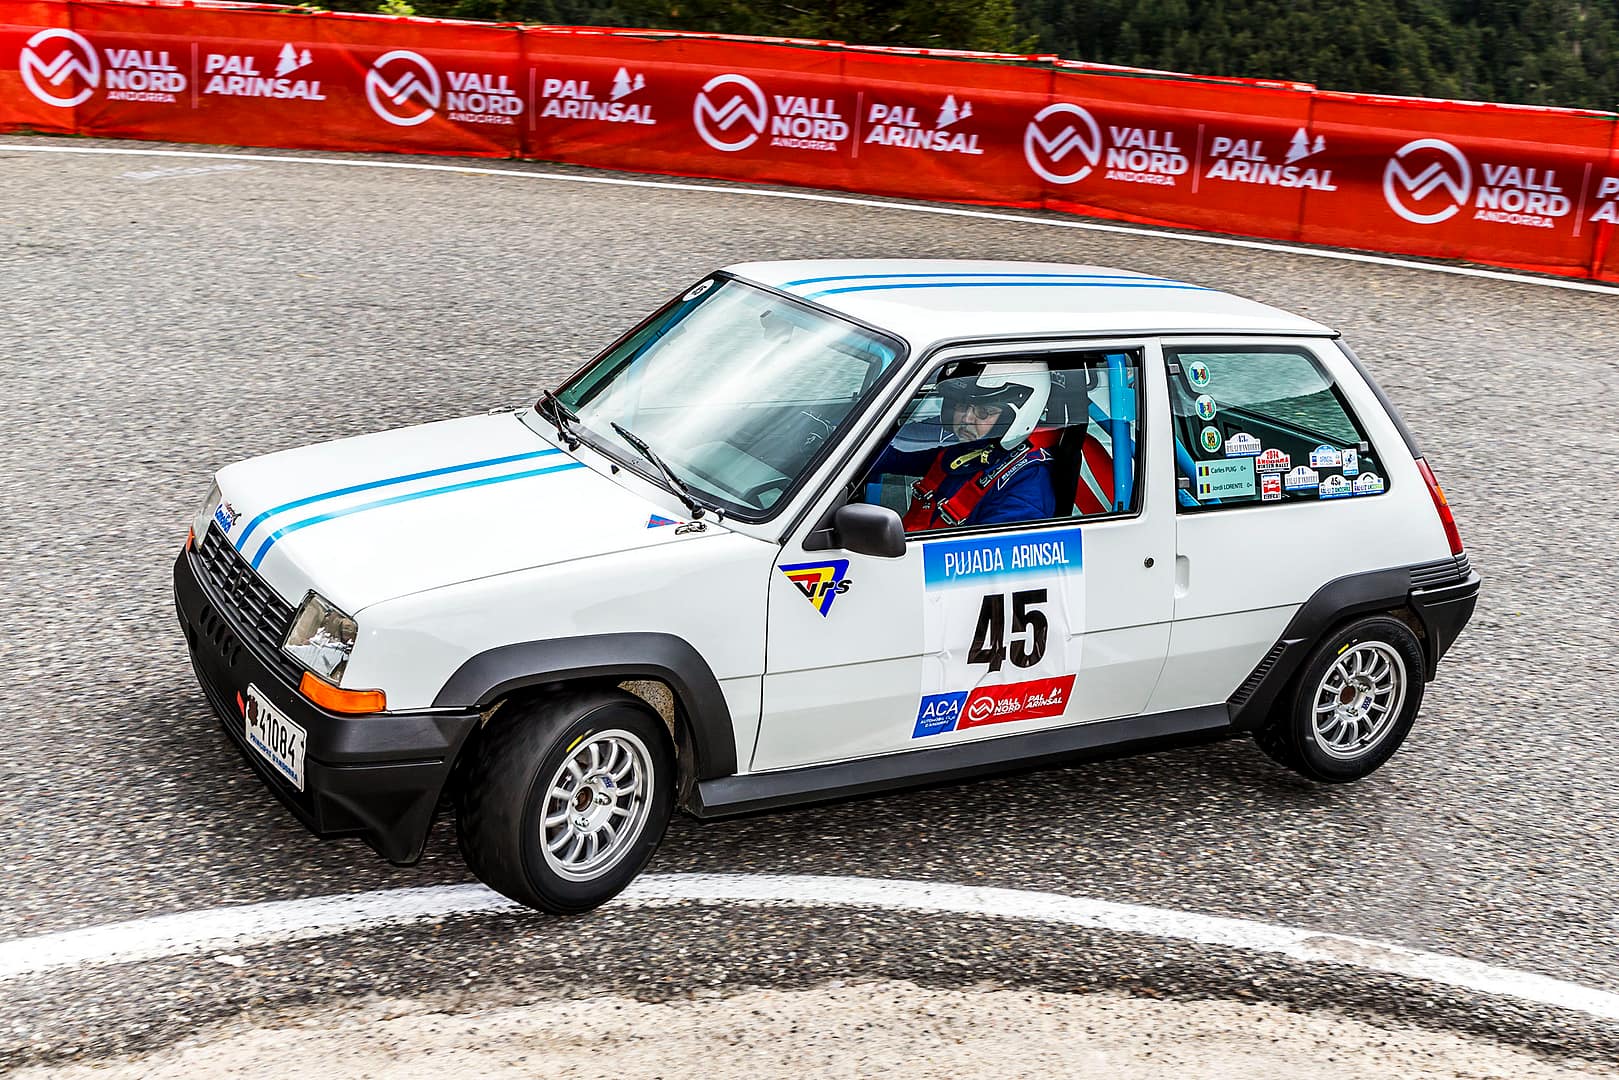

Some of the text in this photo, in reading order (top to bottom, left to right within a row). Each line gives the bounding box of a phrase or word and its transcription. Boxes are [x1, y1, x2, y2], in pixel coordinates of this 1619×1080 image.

[105, 49, 177, 72] VALL
[206, 54, 259, 76] PAL
[106, 69, 187, 93] NORD
[204, 75, 327, 101] ARINSAL
[447, 72, 515, 95] VALL
[543, 79, 593, 100] PAL
[107, 90, 176, 104] ANDORRA
[448, 91, 524, 116] NORD
[774, 95, 842, 119] VALL
[449, 112, 513, 125] ANDORRA
[541, 99, 656, 125] ARINSAL
[869, 104, 920, 127] PAL
[771, 115, 849, 141] NORD
[865, 124, 984, 155] ARINSAL
[1109, 126, 1180, 152] VALL
[771, 137, 837, 152] ANDORRA
[1211, 137, 1266, 162] PAL
[1106, 147, 1189, 176] NORD
[1105, 169, 1175, 187] ANDORRA
[1206, 160, 1337, 191] ARINSAL
[1482, 163, 1562, 192] VALL
[1475, 187, 1572, 218] NORD
[1473, 209, 1554, 229] ANDORRA
[1211, 466, 1225, 474] Carles
[1225, 465, 1237, 473] PUIG
[1224, 482, 1243, 490] LORENTE
[945, 541, 1069, 577] PUJADA ARINSAL
[967, 589, 1048, 673] 45
[922, 699, 959, 718] ACA
[995, 703, 1022, 714] NORD
[998, 698, 1019, 707] VALL
[1025, 697, 1062, 708] ARINSAL
[1028, 694, 1044, 702] PAL
[259, 708, 297, 768] 41084
